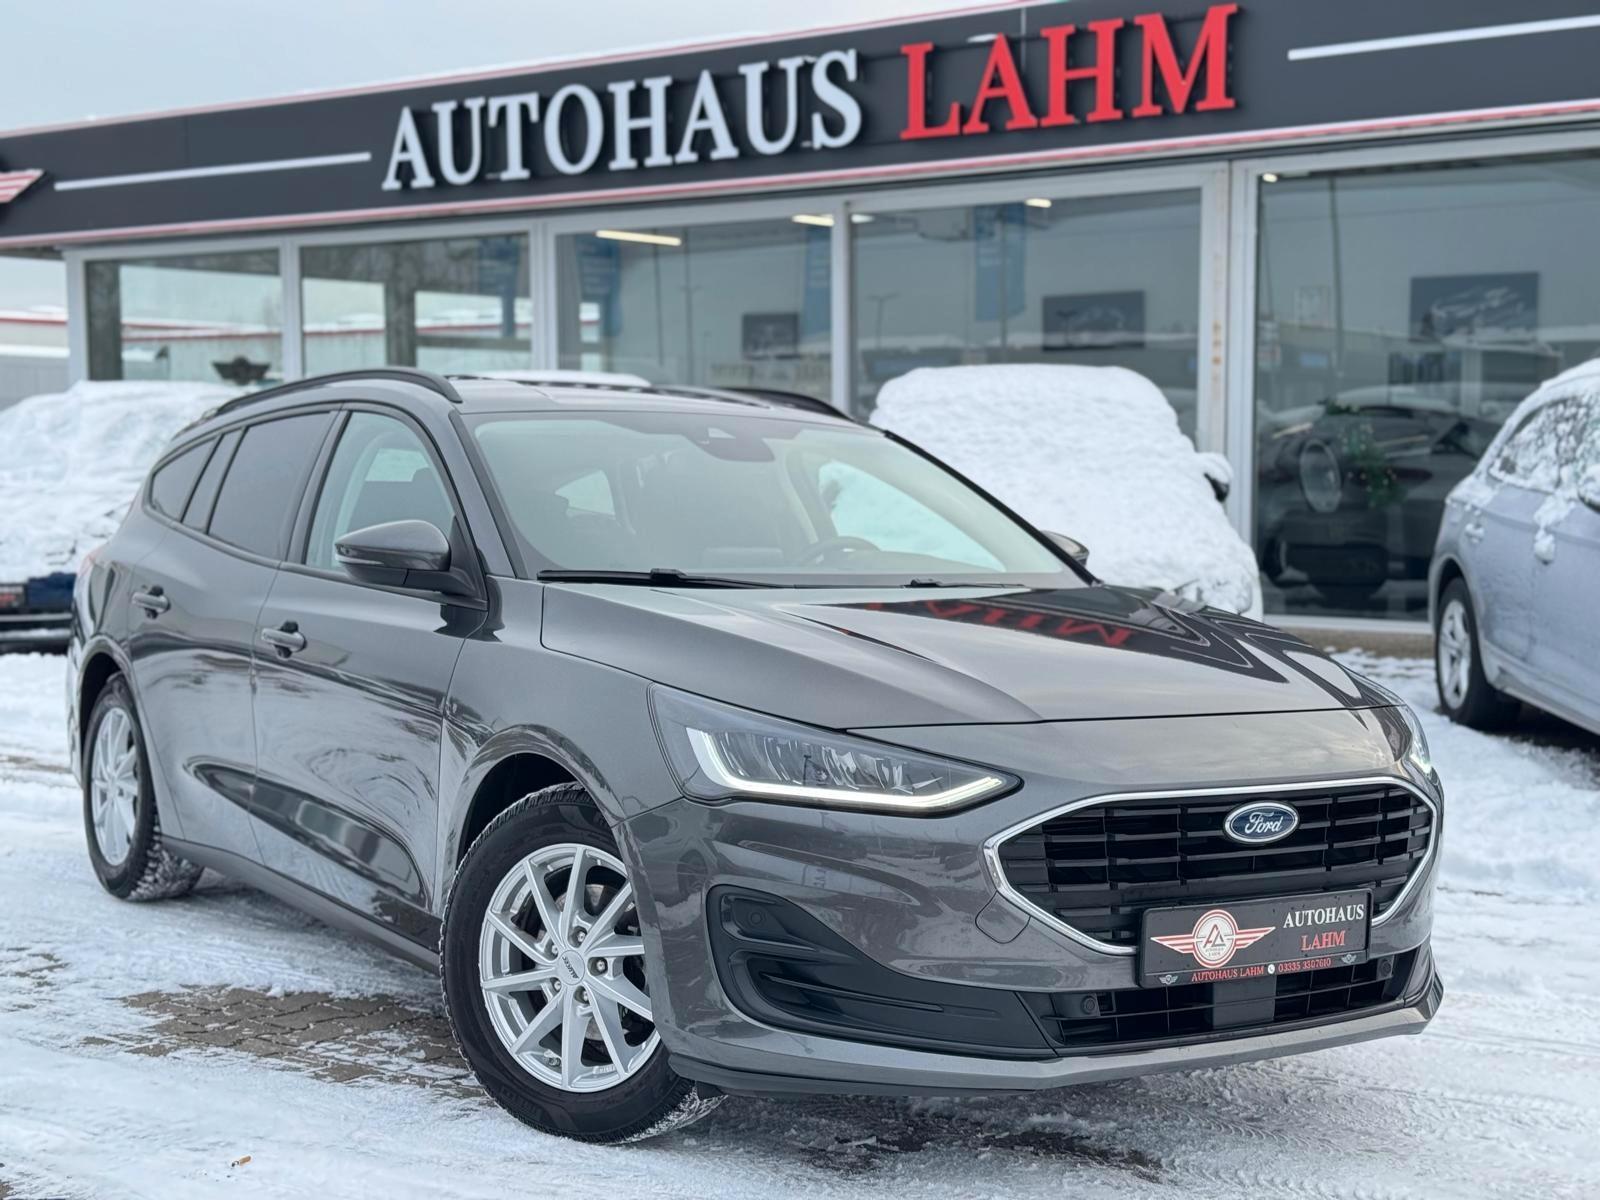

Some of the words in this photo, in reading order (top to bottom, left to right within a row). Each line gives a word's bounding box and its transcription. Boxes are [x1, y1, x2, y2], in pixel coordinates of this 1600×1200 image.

[382, 49, 863, 191] AUTOHAUS
[899, 3, 1239, 141] LAHM
[1244, 811, 1284, 834] Ford
[1283, 903, 1365, 929] AUTOHAUS
[1301, 929, 1346, 952] LAHM
[1191, 967, 1238, 983] AUTOHAUS
[1239, 965, 1265, 979] LAHM
[1277, 959, 1301, 973] 03335
